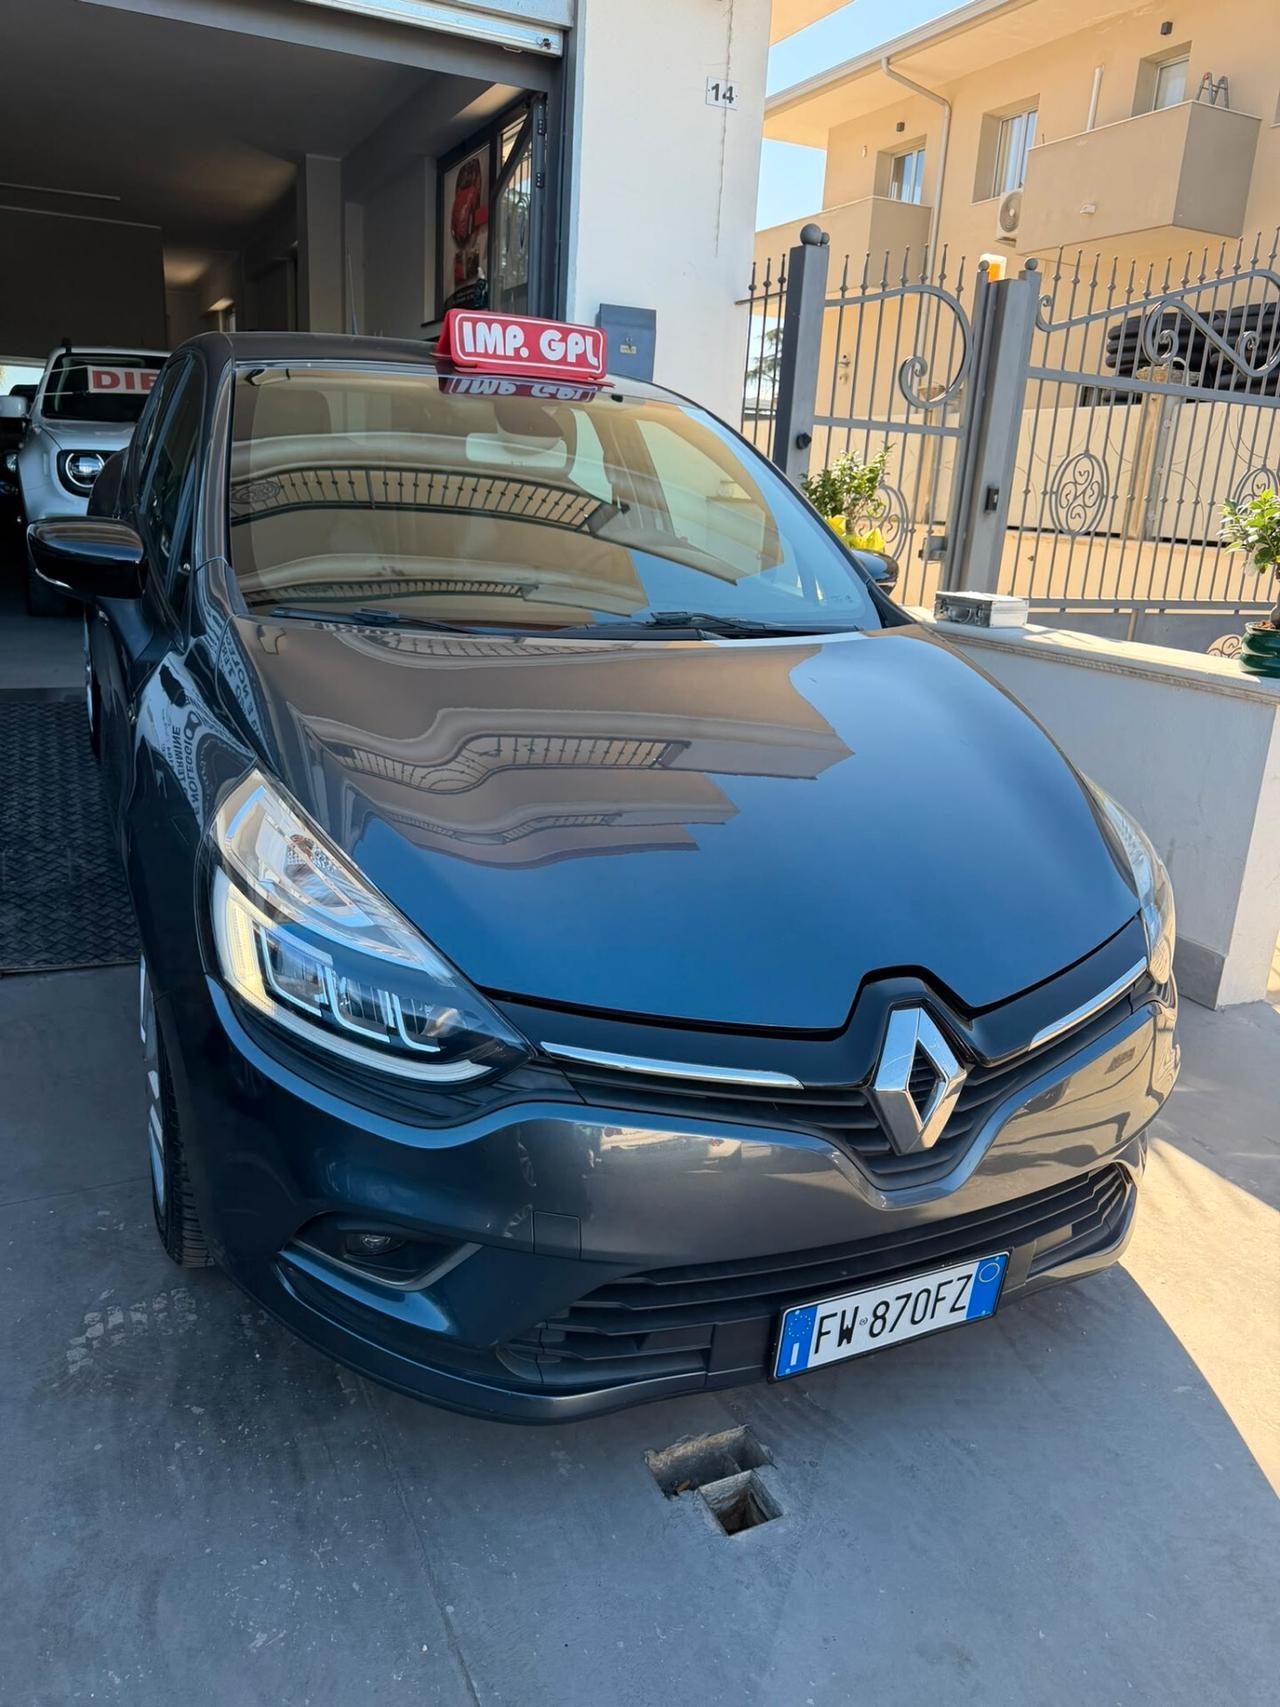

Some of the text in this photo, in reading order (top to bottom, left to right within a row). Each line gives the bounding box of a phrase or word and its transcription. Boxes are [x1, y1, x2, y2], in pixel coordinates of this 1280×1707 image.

[711, 83, 734, 104] 14
[463, 321, 599, 366] IMP. GPL
